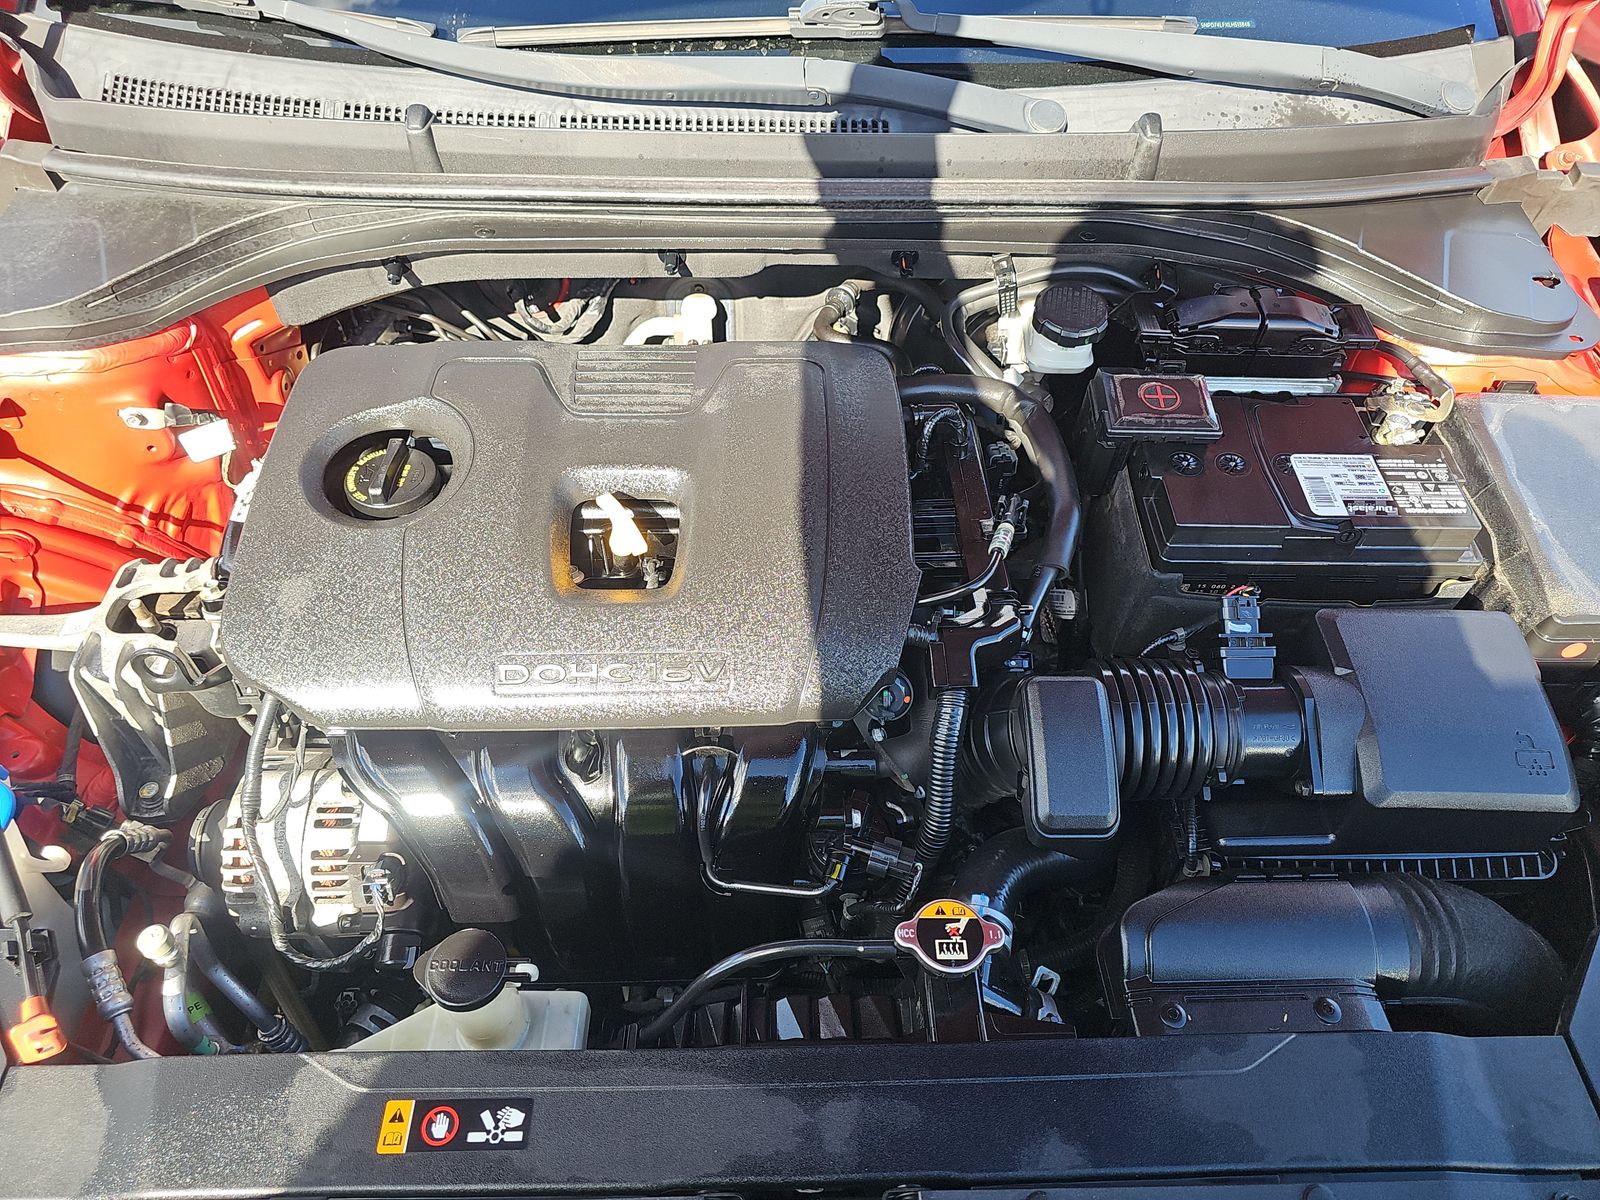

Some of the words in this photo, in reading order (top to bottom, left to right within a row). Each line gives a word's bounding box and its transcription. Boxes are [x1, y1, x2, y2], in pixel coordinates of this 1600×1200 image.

[1348, 505, 1393, 513] Duralast
[498, 663, 634, 685] DOHC
[650, 660, 727, 683] 16V
[898, 928, 915, 938] HCC
[989, 929, 1001, 939] 1.1
[429, 958, 504, 973] COOLANT
[187, 1001, 203, 1014] PE
